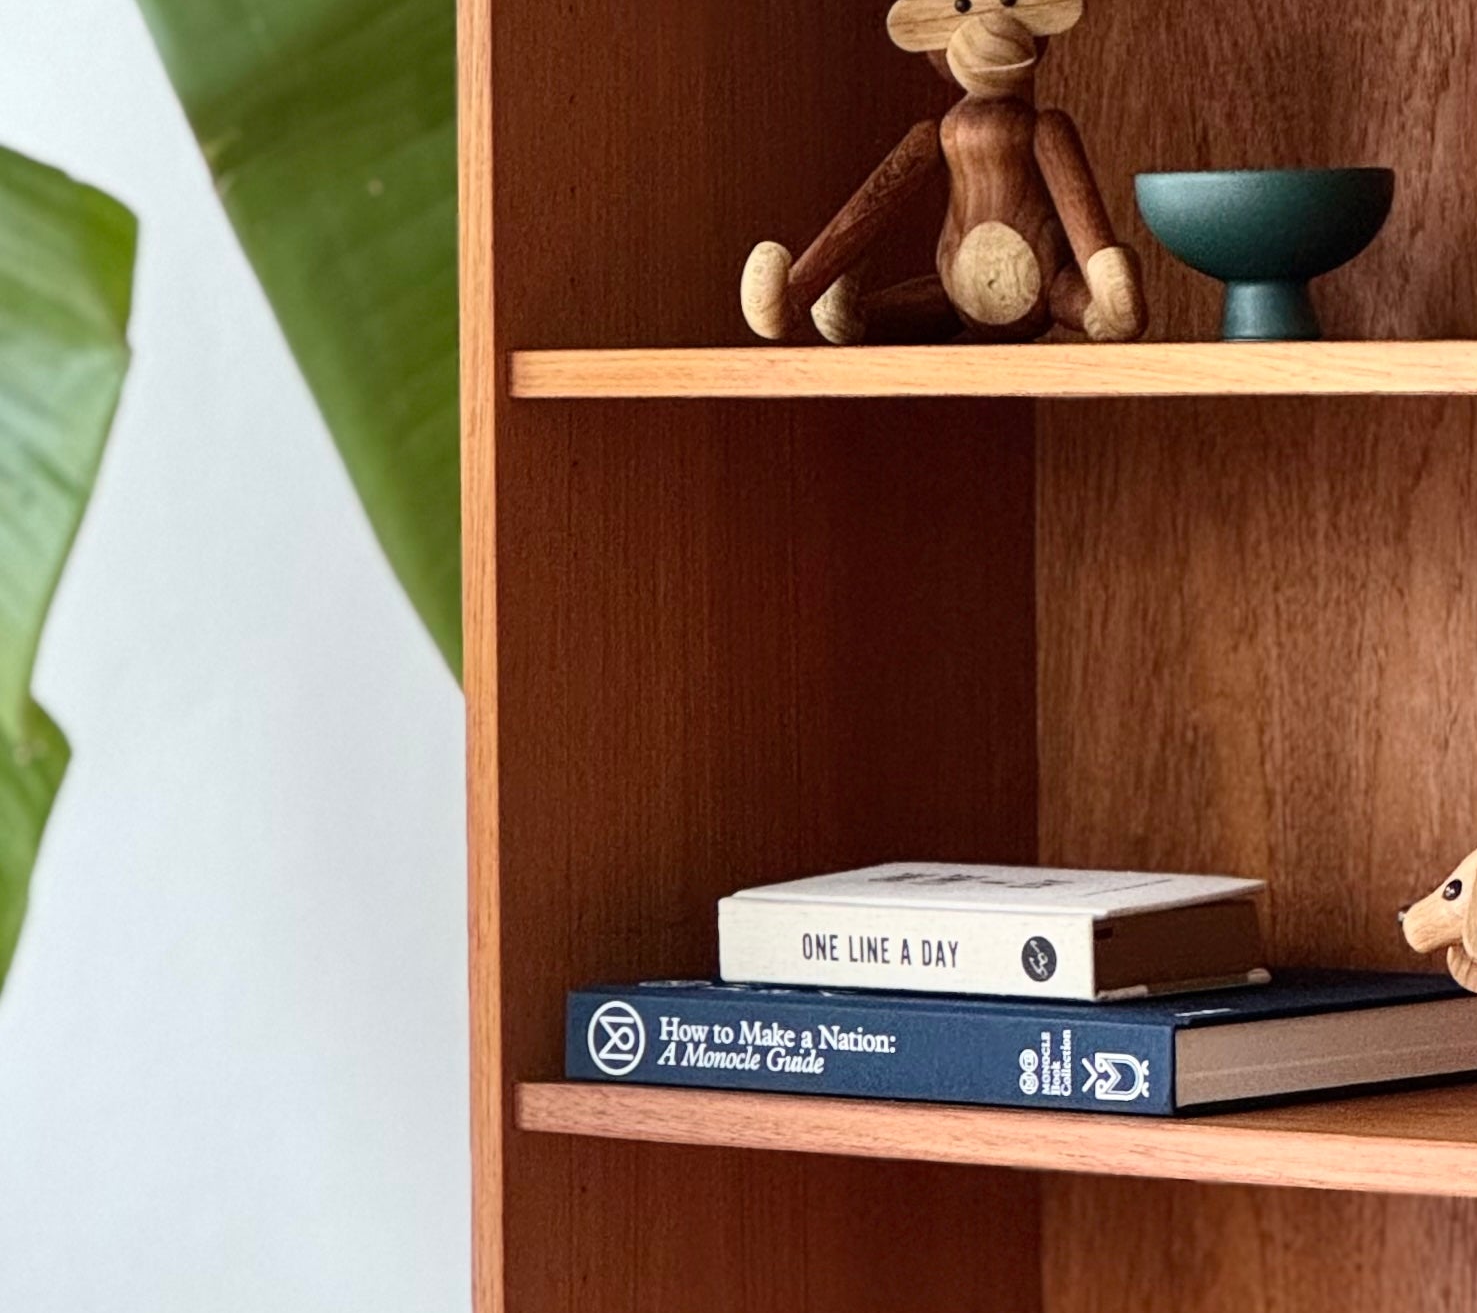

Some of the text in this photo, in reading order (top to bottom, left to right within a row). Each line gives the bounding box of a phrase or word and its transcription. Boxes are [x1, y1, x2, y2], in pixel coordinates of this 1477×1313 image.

[802, 933, 958, 968] ONE LINE A DAY
[659, 1016, 897, 1054] How to Make a Nation:
[657, 1041, 825, 1074] A Monocle Guide
[1041, 1031, 1051, 1096] MONOCLE
[1060, 1029, 1072, 1097] Collection
[1051, 1060, 1061, 1096] Book
